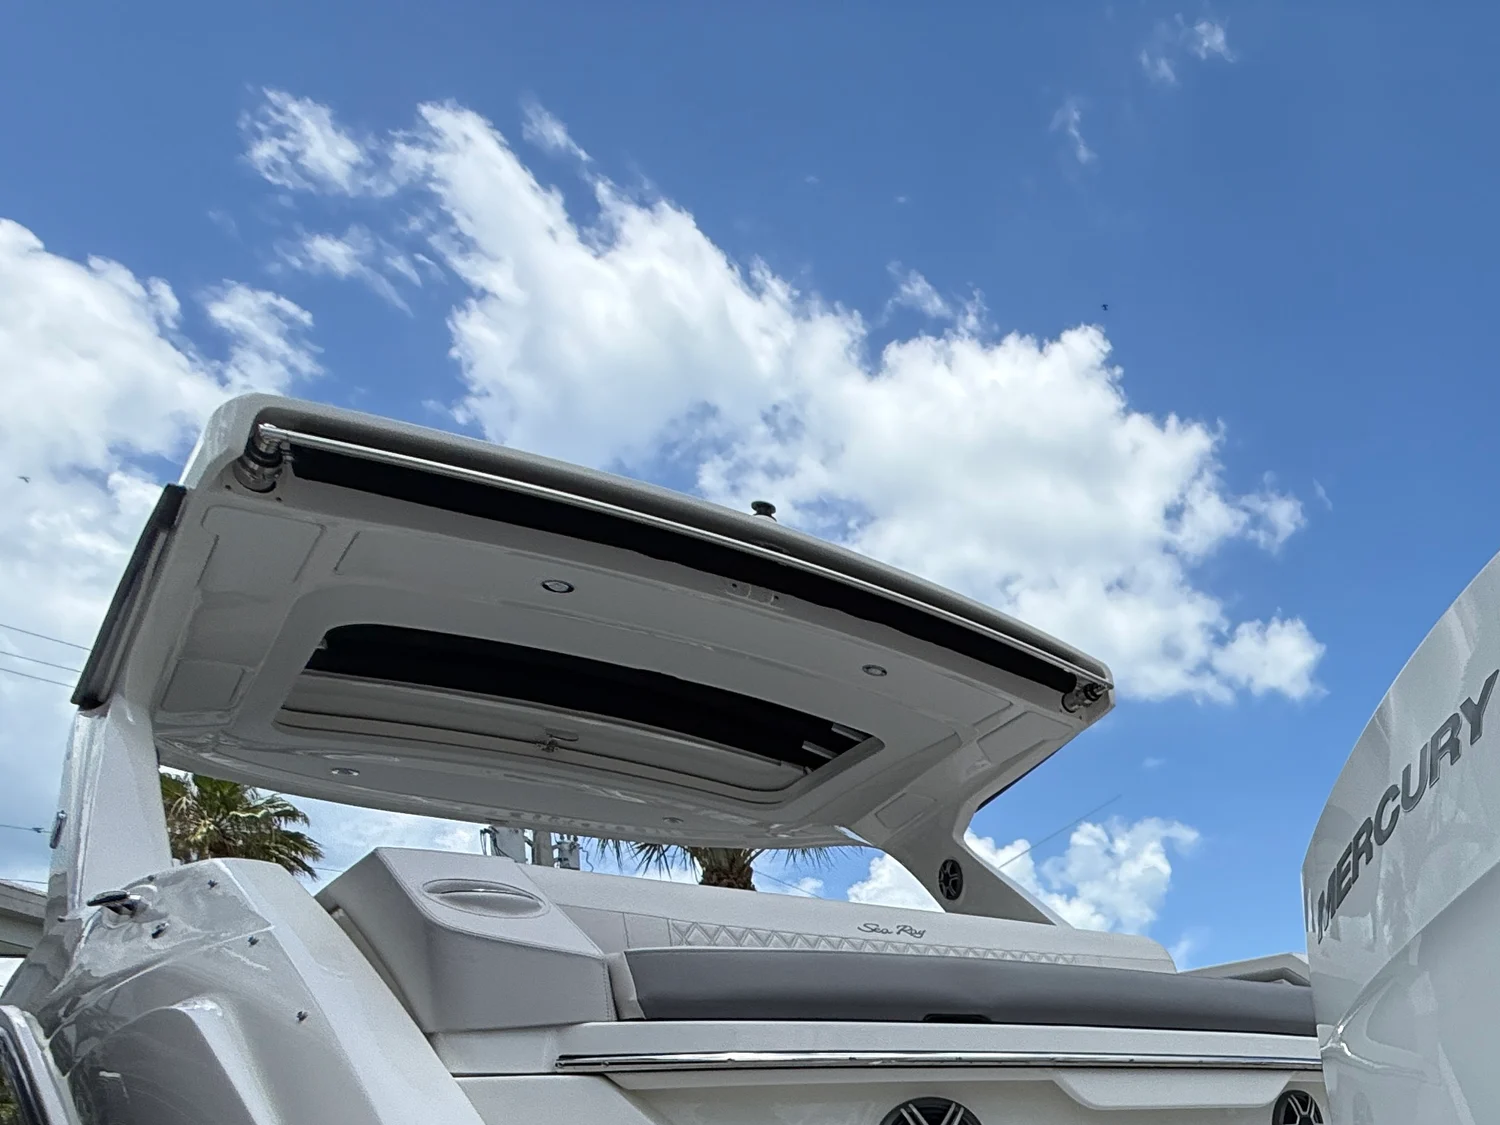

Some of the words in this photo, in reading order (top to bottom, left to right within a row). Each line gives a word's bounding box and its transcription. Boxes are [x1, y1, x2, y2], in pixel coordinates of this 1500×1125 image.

[1317, 669, 1500, 945] MERCURY
[857, 922, 893, 936] Sea
[896, 924, 926, 939] Ray
